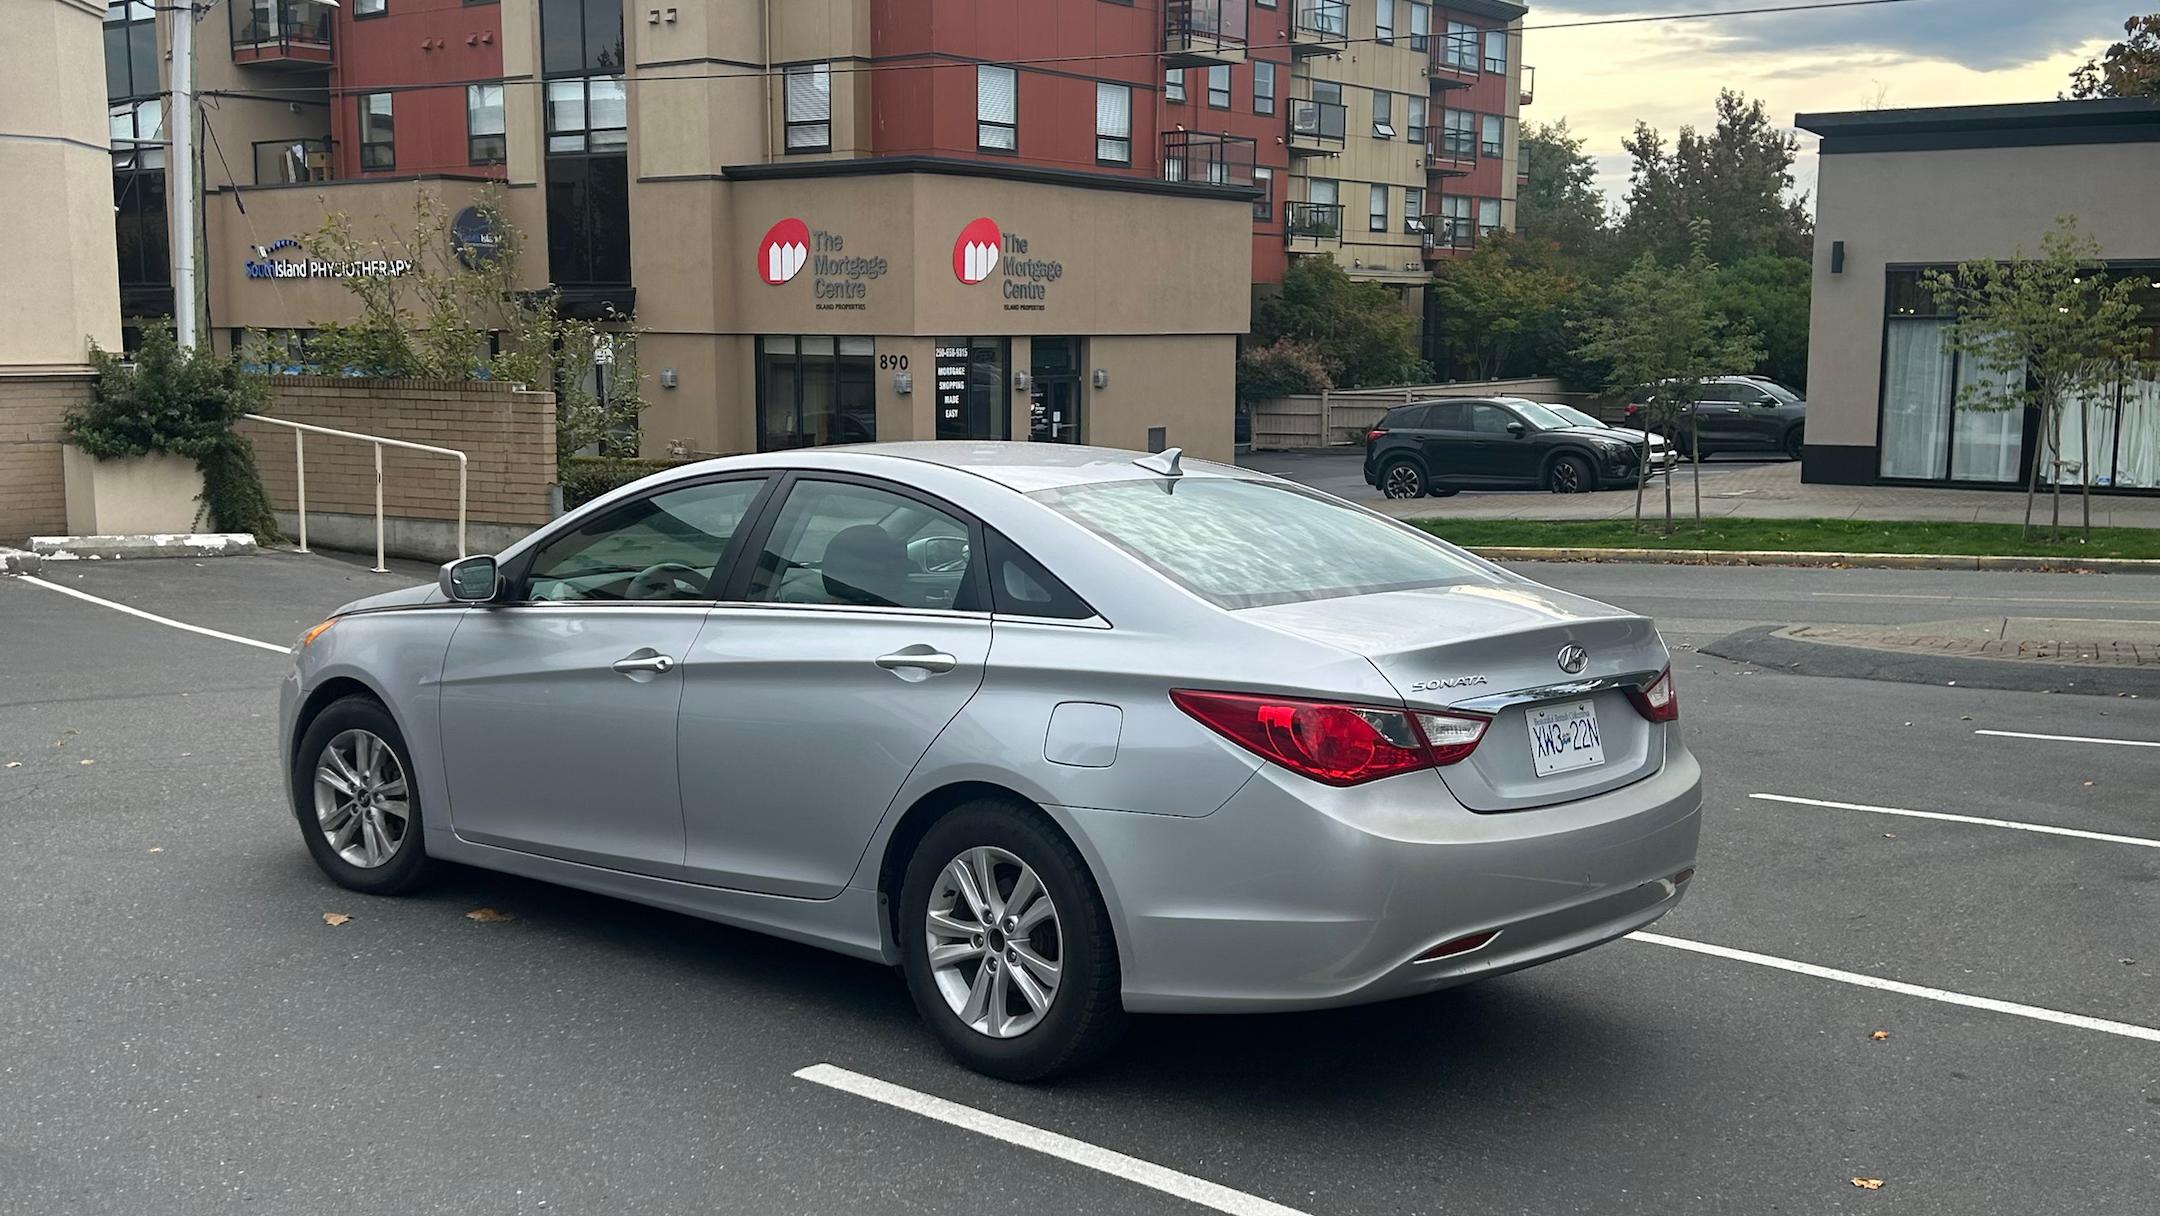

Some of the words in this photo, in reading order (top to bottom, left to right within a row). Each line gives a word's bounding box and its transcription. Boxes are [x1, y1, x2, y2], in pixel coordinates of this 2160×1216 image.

[814, 230, 844, 252] The
[1003, 232, 1028, 254] The
[814, 255, 887, 279] Mortgage
[1003, 256, 1063, 282] Mortgage
[815, 278, 866, 299] Centre
[1003, 279, 1045, 300] Centre
[880, 354, 909, 371] 890
[938, 366, 965, 376] MORTGAGE
[939, 381, 965, 390] SHOPPING
[944, 395, 959, 404] MADE
[945, 409, 958, 418] EASY
[1412, 675, 1487, 693] SONATA
